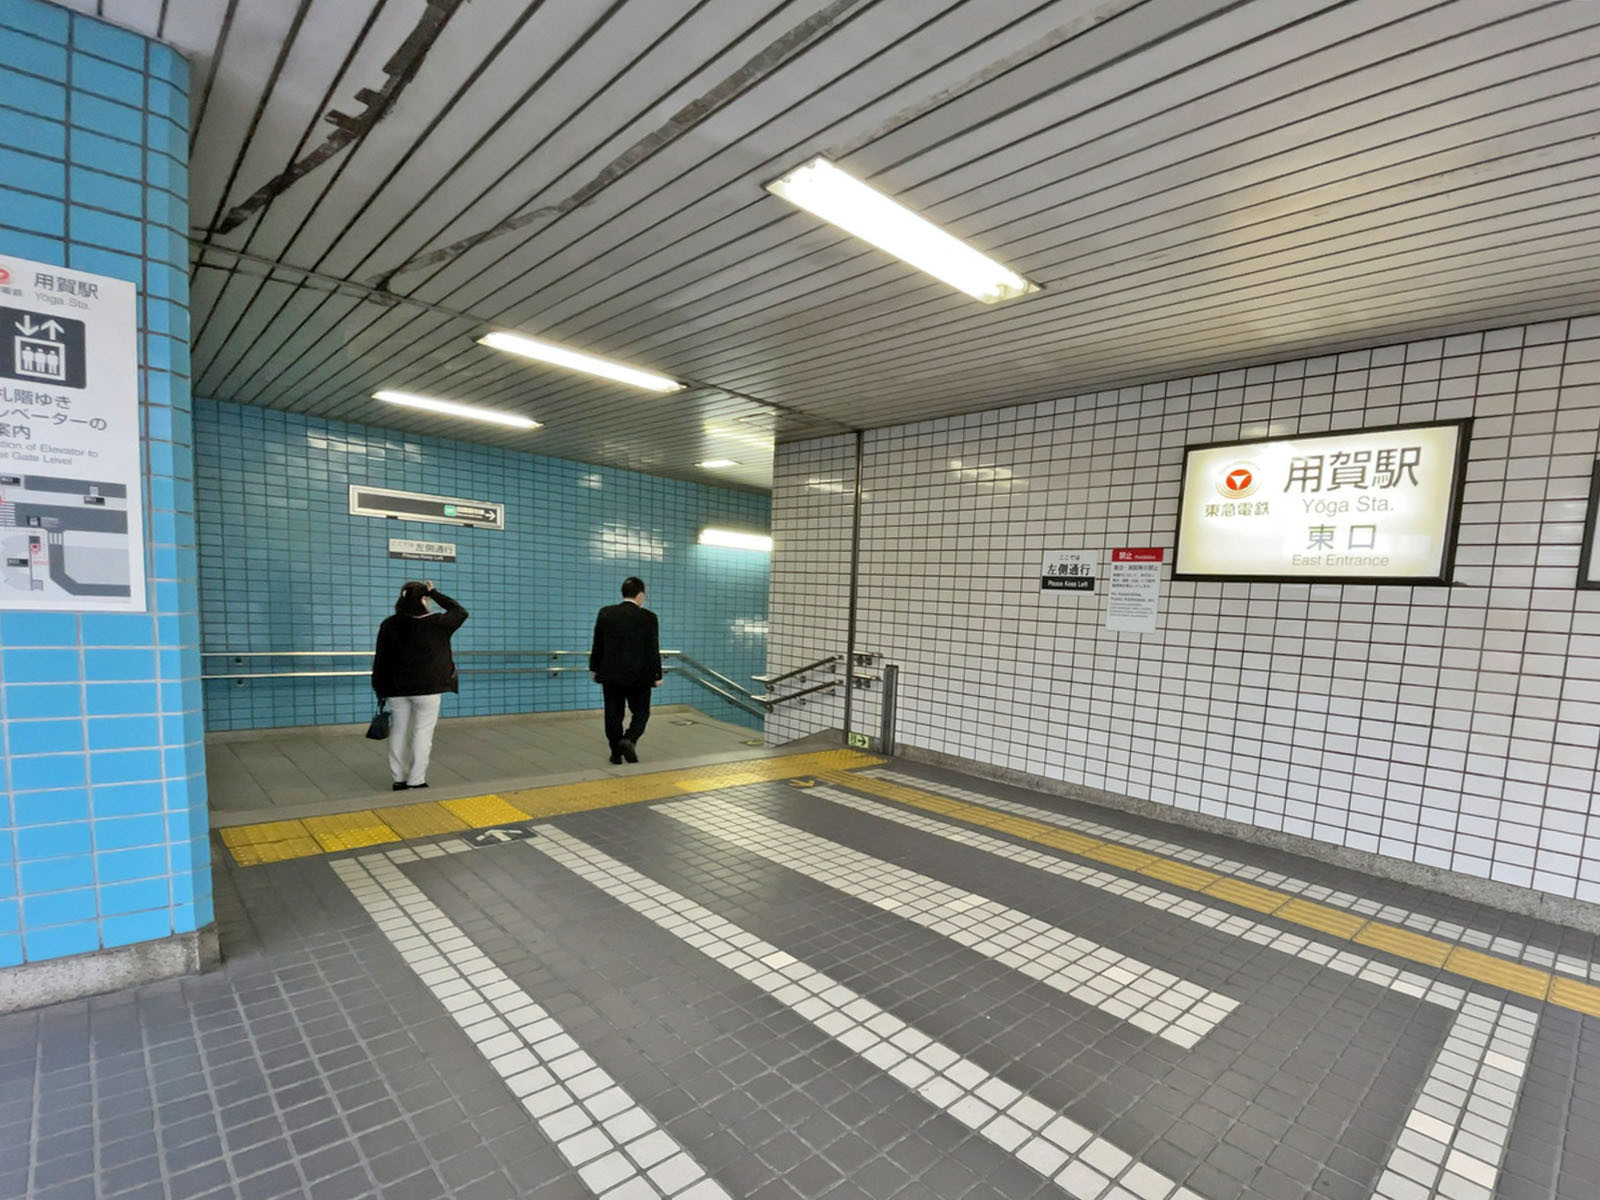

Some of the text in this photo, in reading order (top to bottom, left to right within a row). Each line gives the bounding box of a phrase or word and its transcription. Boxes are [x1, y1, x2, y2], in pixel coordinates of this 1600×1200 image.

[34, 273, 98, 300] 用賀駅
[40, 443, 84, 456] Elevator
[88, 450, 98, 458] to
[43, 455, 73, 465] Level
[1283, 446, 1422, 494] 用賀駅
[1205, 501, 1270, 518] 東急電鉄
[1356, 495, 1394, 512] Sta.
[1306, 523, 1377, 551] 東口
[1292, 553, 1390, 567] East Entrance
[1047, 563, 1091, 576] 左側通行
[1064, 580, 1077, 588] Keep
